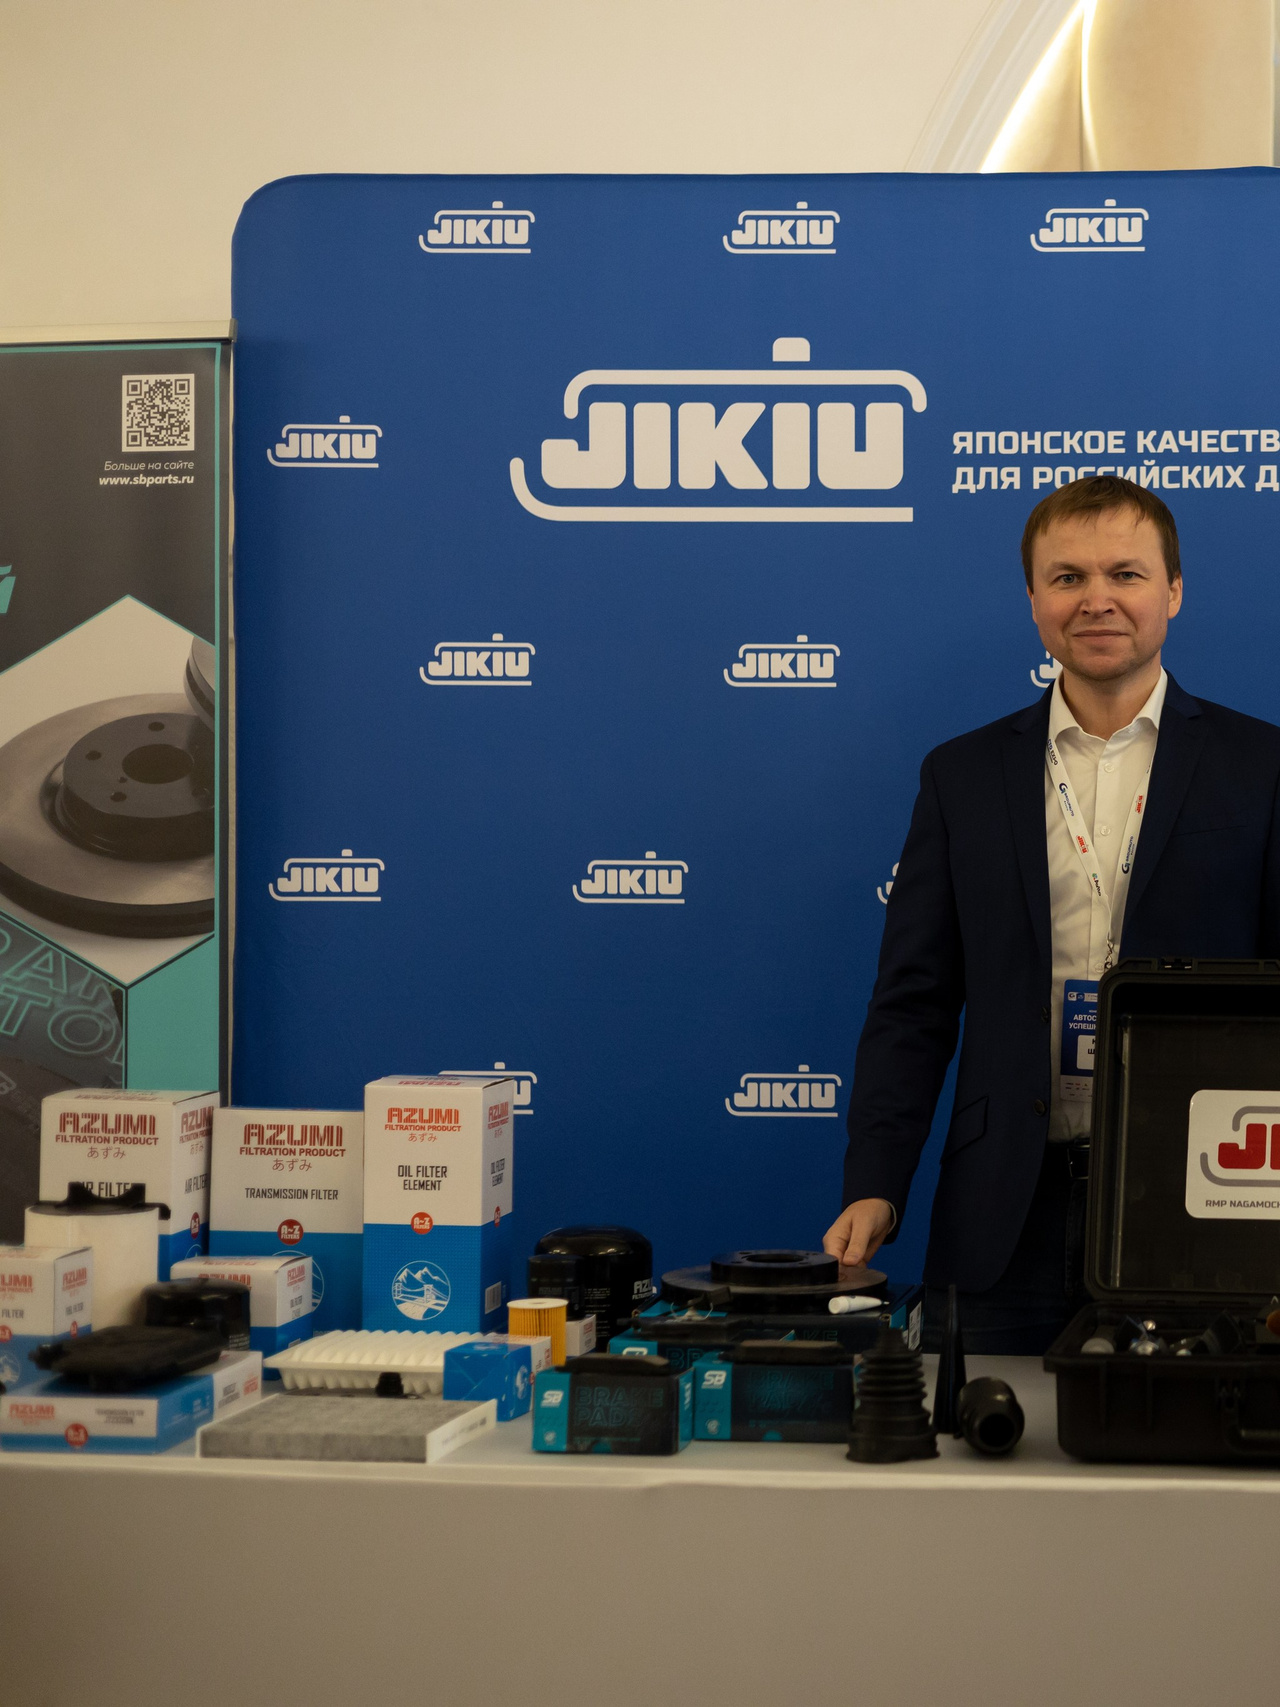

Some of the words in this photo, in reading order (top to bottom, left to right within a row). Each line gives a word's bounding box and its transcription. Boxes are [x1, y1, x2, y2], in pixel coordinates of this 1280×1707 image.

[428, 201, 528, 245] JIKIU
[732, 202, 833, 245] JIKIU
[1039, 199, 1142, 243] JIKIU
[541, 338, 904, 490] JIKIU
[276, 416, 377, 459] JIKIU
[952, 430, 1125, 455] ЯПОНСКОЕ
[104, 460, 146, 471] Больше
[148, 462, 161, 470] на
[164, 460, 195, 470] сайте
[99, 473, 195, 488] www.sbparts.ru
[952, 466, 1020, 494] ДЛЯ
[428, 634, 530, 677] JIKIU
[733, 635, 834, 678] JIKIU
[278, 849, 379, 893] JIKIU
[581, 851, 683, 895] JIKIU
[1073, 1014, 1097, 1022] АВТОС
[734, 1065, 836, 1108] JIKIU
[59, 1112, 156, 1135] AZUMI
[387, 1107, 460, 1124] AZUMI
[55, 1135, 110, 1145] FILTRATION
[113, 1136, 159, 1146] PRODUCT
[243, 1123, 343, 1147] AZUMI
[408, 1132, 437, 1143] あずみ
[87, 1146, 126, 1159] あずみ
[239, 1147, 297, 1156] FILTRATION
[299, 1148, 346, 1157] PRODUCT
[272, 1158, 313, 1172] あずみ
[397, 1165, 413, 1178] OIL
[416, 1165, 448, 1178] FILTER
[98, 1181, 131, 1197] FILTE
[245, 1188, 309, 1200] TRANSMISSION
[310, 1189, 339, 1200] FILTER
[403, 1180, 442, 1191] ELEMENT
[1205, 1199, 1227, 1208] RMP
